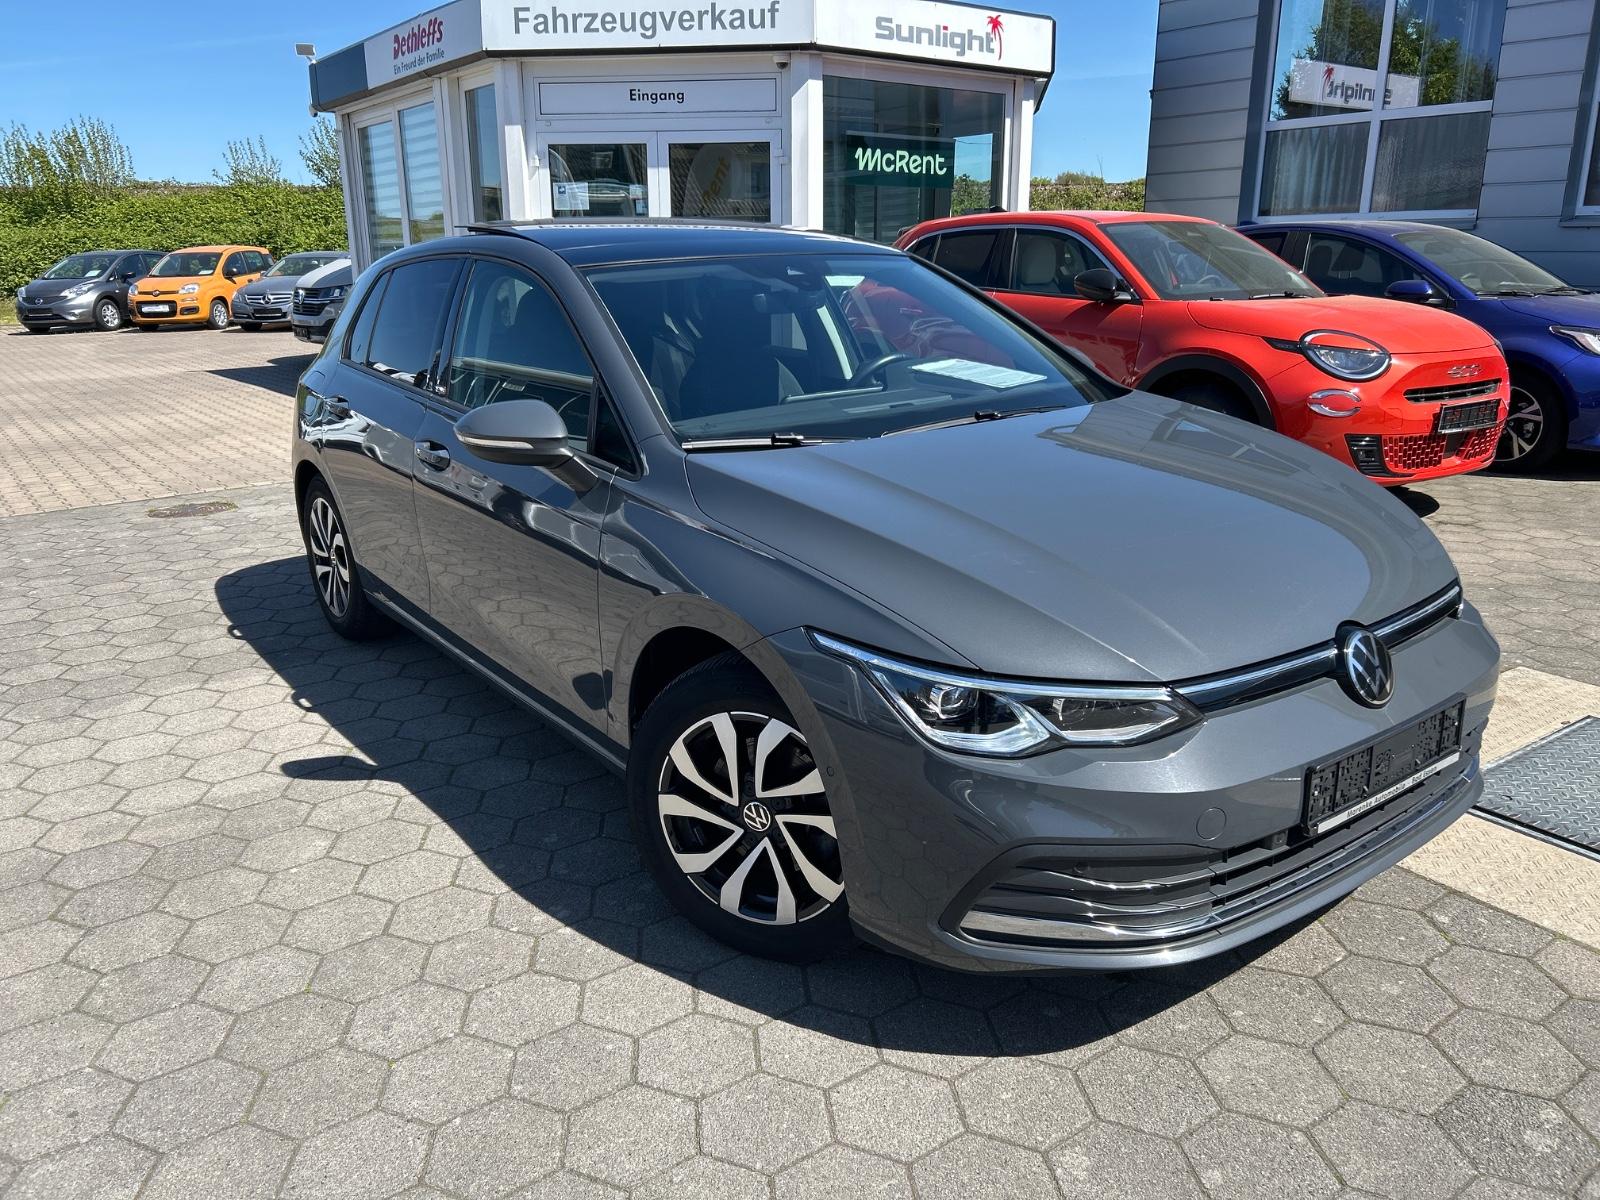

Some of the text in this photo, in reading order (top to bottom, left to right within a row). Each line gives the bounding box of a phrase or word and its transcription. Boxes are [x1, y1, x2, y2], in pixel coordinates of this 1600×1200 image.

[393, 17, 444, 60] Dethleffs
[513, 1, 780, 39] Fahrzeugverkauf
[875, 16, 995, 57] Sunlight
[629, 88, 685, 103] Eingang
[854, 147, 948, 175] McRent
